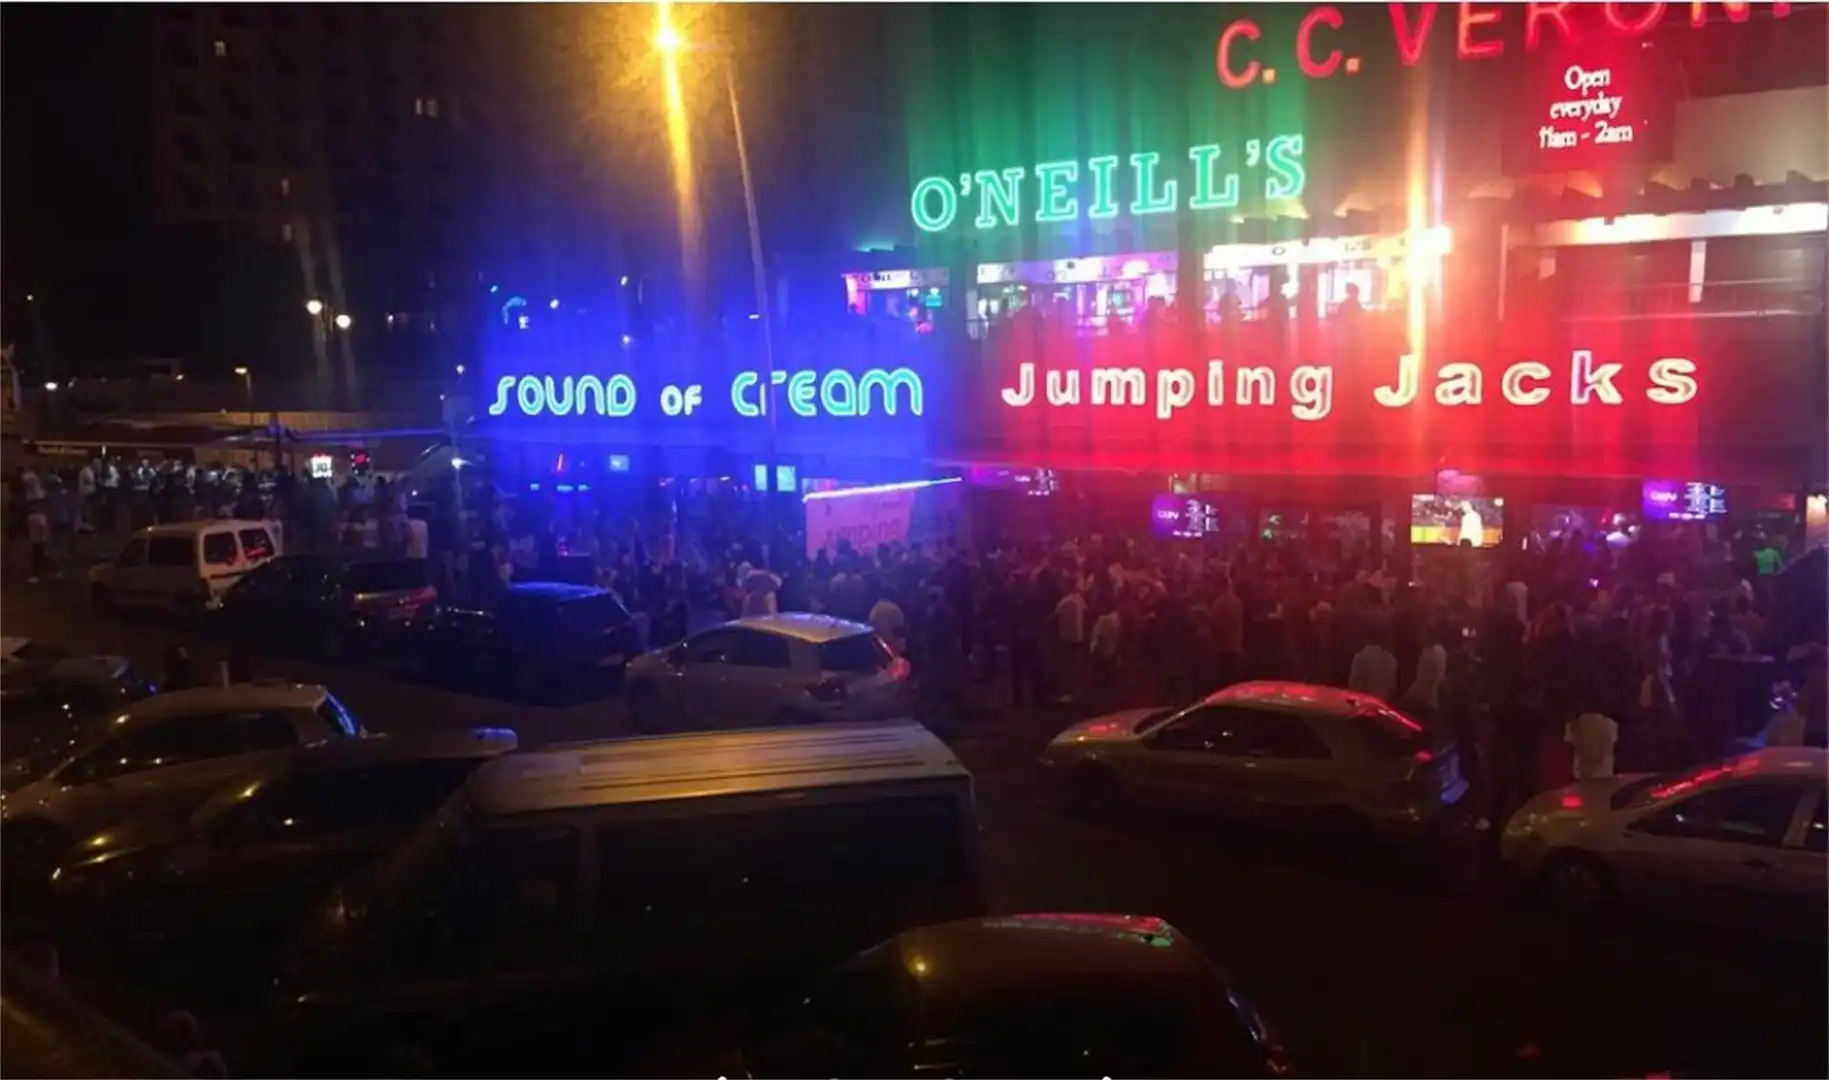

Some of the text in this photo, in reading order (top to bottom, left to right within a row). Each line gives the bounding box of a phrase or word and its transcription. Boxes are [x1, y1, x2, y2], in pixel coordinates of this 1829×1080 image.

[1389, 2, 1790, 66] VERO
[1564, 65, 1611, 97] Open
[1550, 90, 1623, 122] everyday
[1539, 125, 1577, 149] 11am
[1594, 120, 1633, 144] 2am
[911, 133, 1306, 232] O'NEILL'S
[488, 374, 637, 416] SOUND
[1001, 350, 1700, 420] Jumping Jacks
